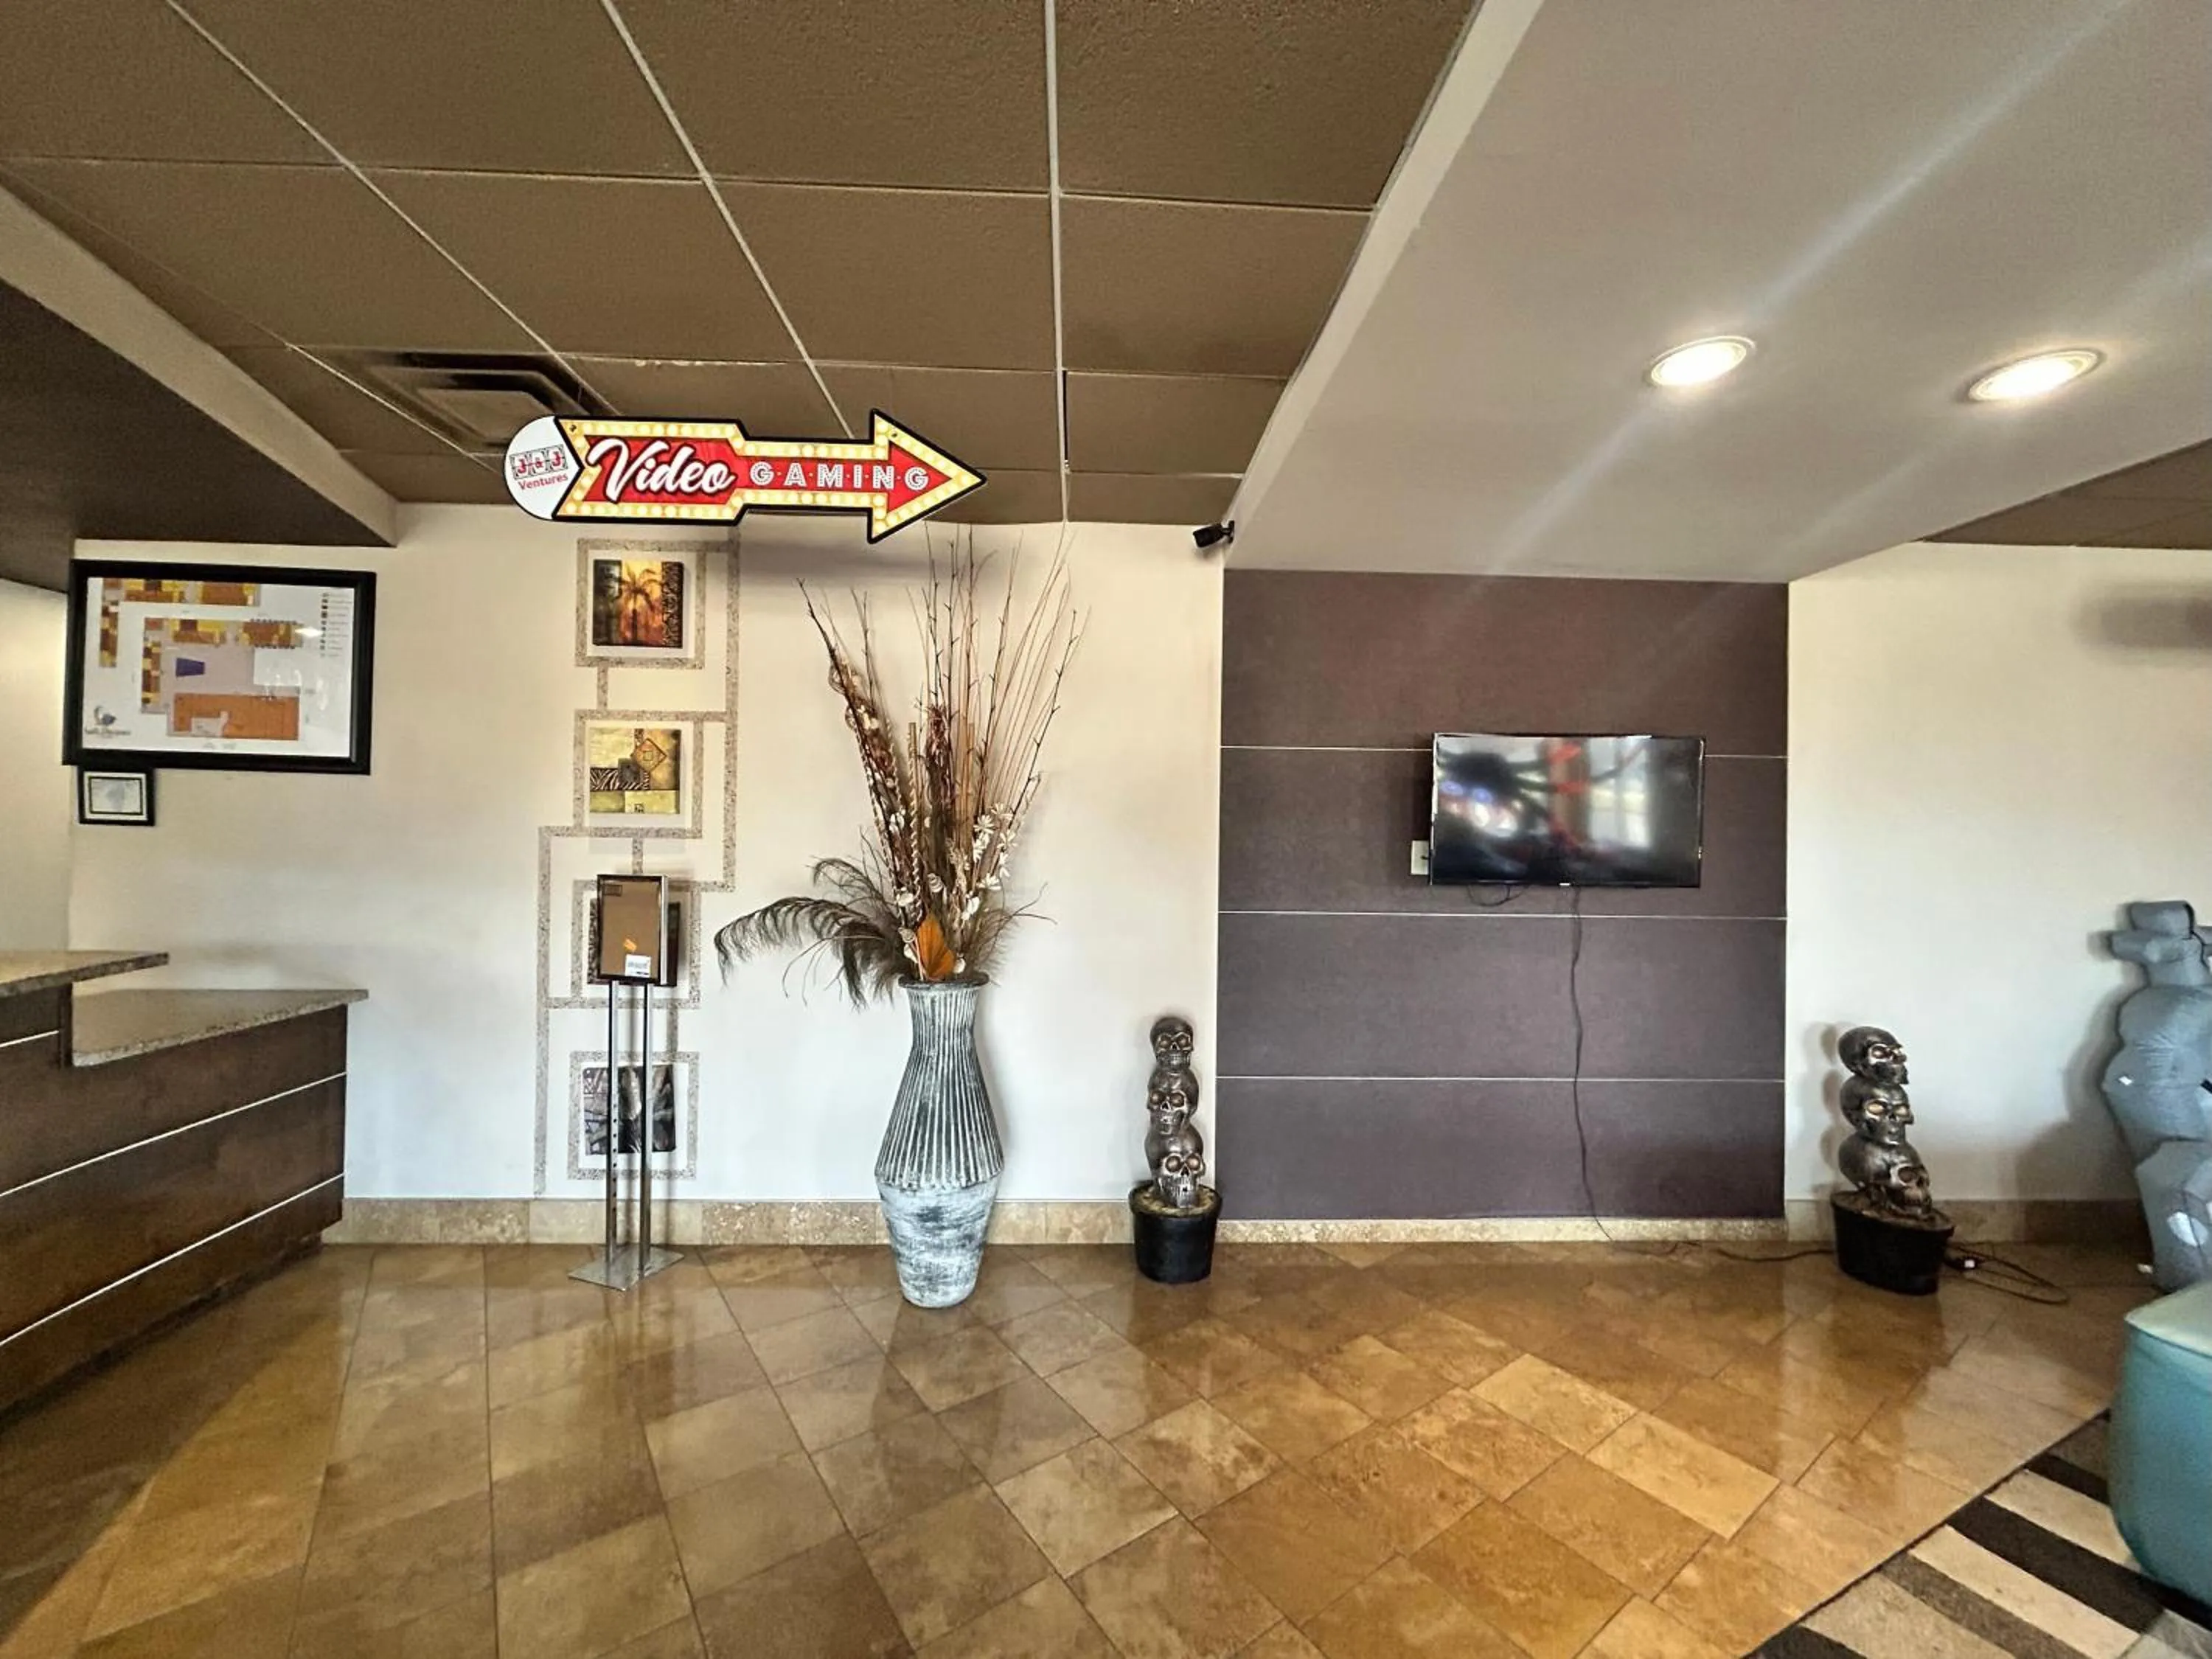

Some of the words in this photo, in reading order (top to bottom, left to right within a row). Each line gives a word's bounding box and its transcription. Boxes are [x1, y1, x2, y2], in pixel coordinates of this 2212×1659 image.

[518, 473, 568, 490] Ventures
[587, 437, 737, 502] Video
[749, 461, 929, 491] GAMING
